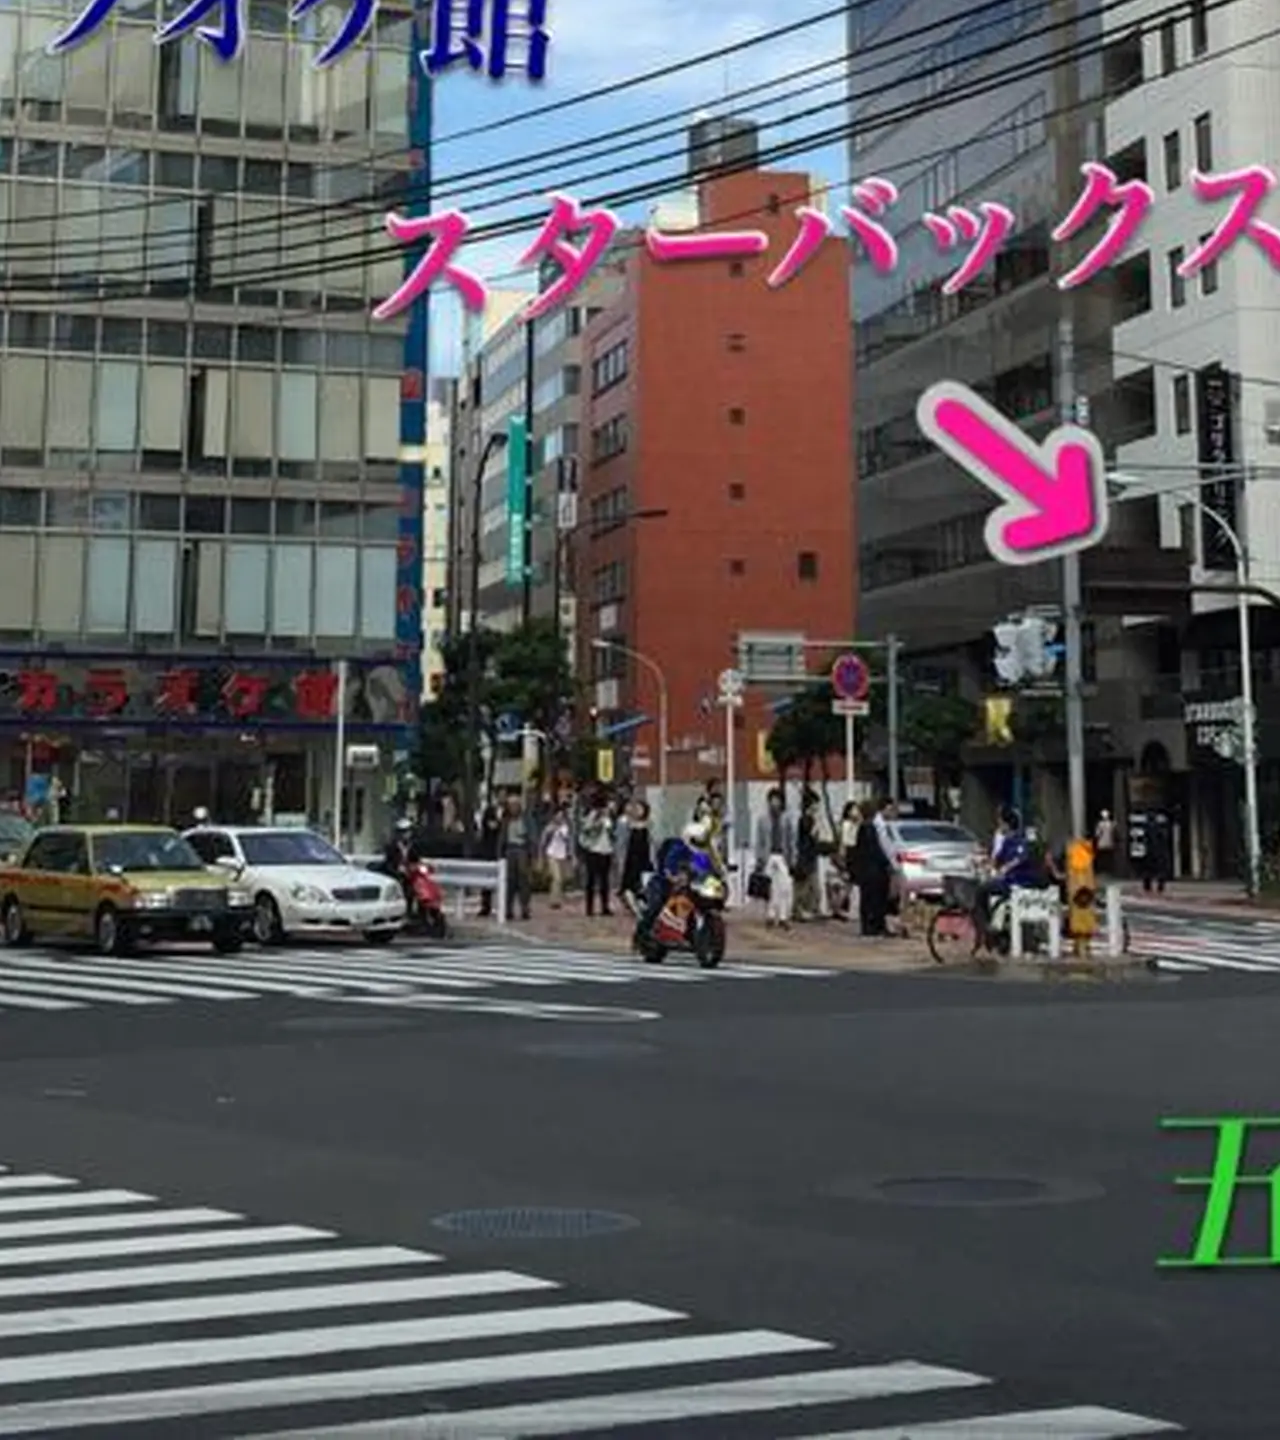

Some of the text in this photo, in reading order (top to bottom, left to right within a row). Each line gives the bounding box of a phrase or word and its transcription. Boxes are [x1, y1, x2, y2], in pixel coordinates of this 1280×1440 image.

[16, 667, 340, 719] カラオケ館
